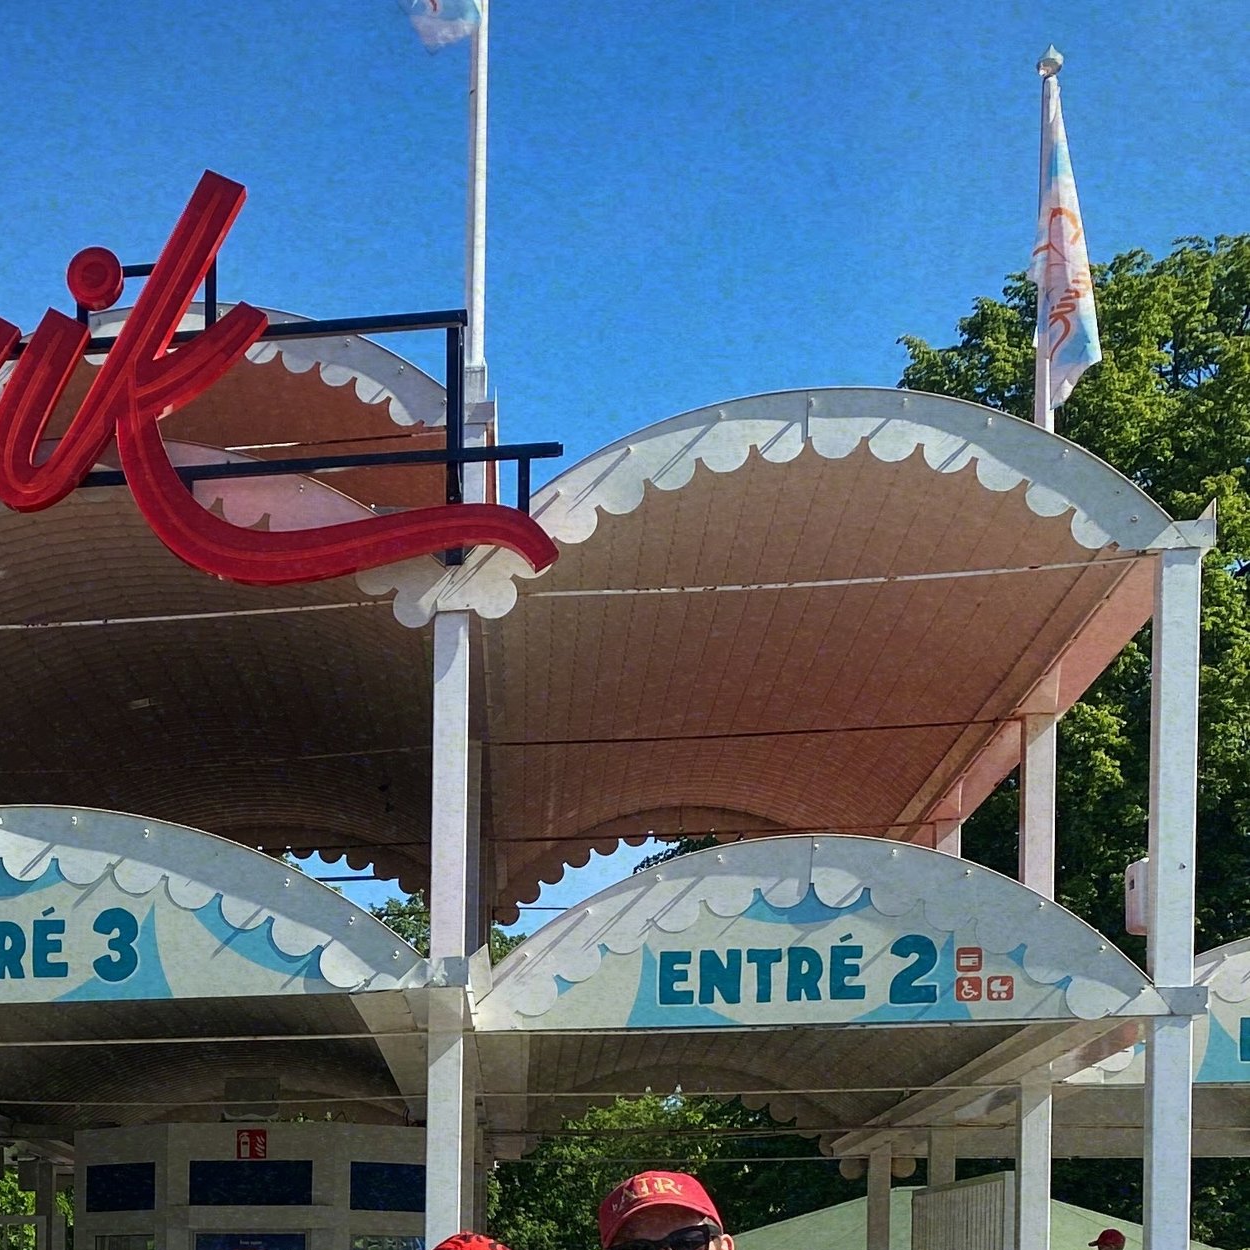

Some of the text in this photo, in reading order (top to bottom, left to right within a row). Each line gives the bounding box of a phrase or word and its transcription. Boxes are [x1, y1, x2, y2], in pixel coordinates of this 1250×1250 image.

[93, 907, 139, 982] 3
[659, 933, 937, 1005] ENTRÉ 2
